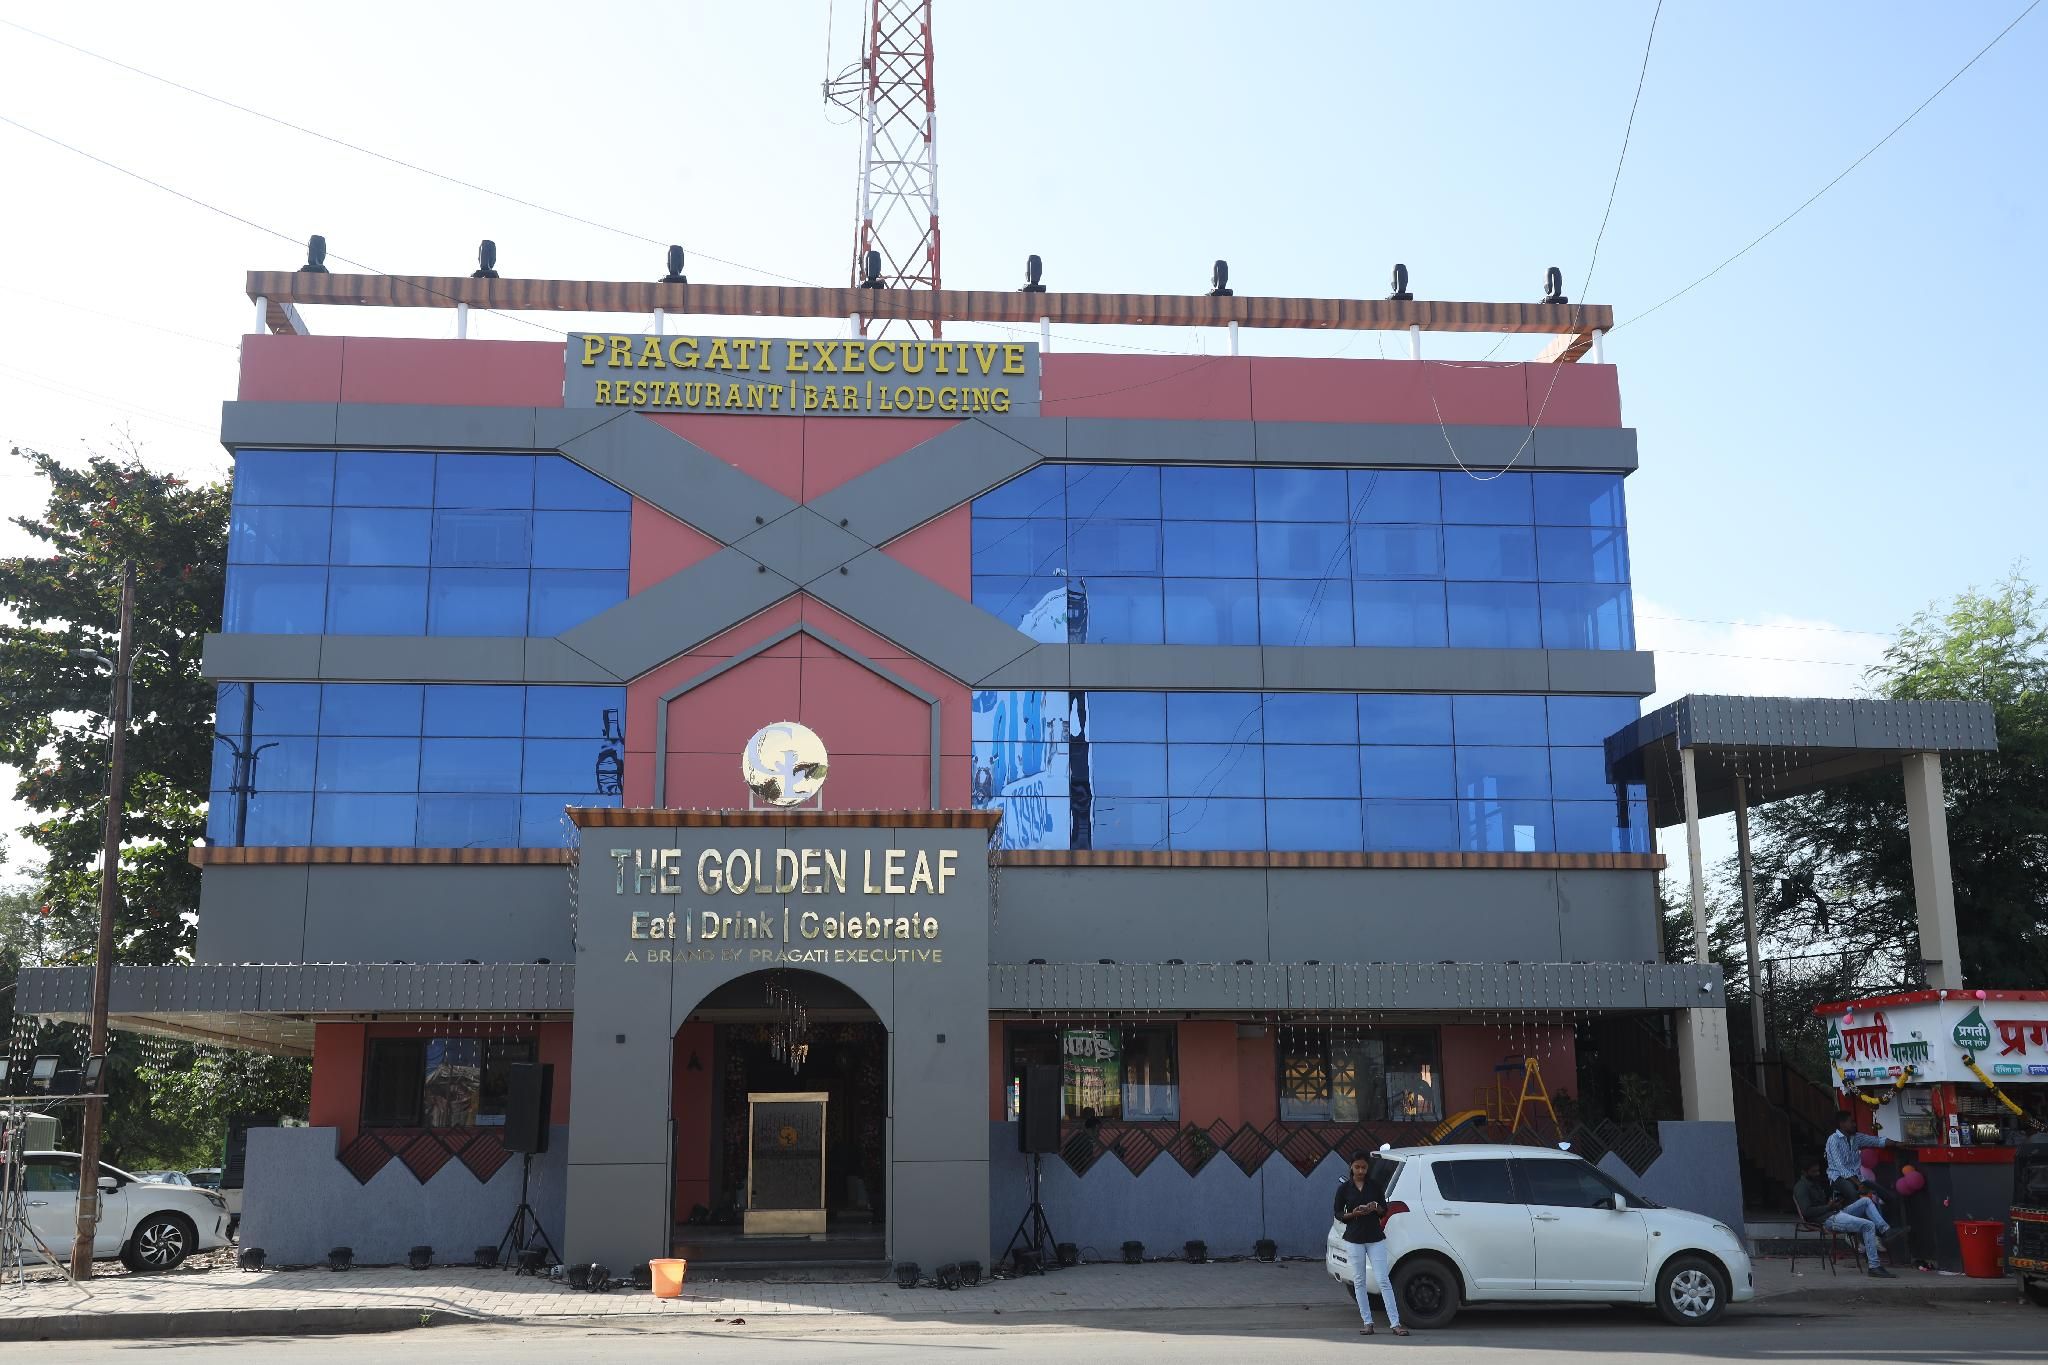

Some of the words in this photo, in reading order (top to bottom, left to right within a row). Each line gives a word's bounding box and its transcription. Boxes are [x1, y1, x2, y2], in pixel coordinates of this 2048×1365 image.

[581, 334, 772, 371] PRAGATI
[785, 340, 1026, 375] EXECUTIVE
[595, 380, 784, 409] RESTAURANT
[804, 384, 859, 410] BAR
[879, 386, 1011, 412] LODGING
[610, 848, 682, 894] THE
[697, 848, 847, 895] GOLDEN
[863, 849, 958, 894] LEAF
[631, 911, 677, 939] Eat
[701, 910, 774, 939] Drink
[800, 911, 939, 939] Celebrate
[624, 949, 640, 963] A
[647, 949, 714, 963] BRAND
[721, 949, 743, 962] BY
[749, 949, 829, 963] PRAGATI
[834, 949, 943, 963] EXECUTIVE
[1841, 1011, 1890, 1062] प्रगती
[1957, 1023, 1988, 1038] प्रगती
